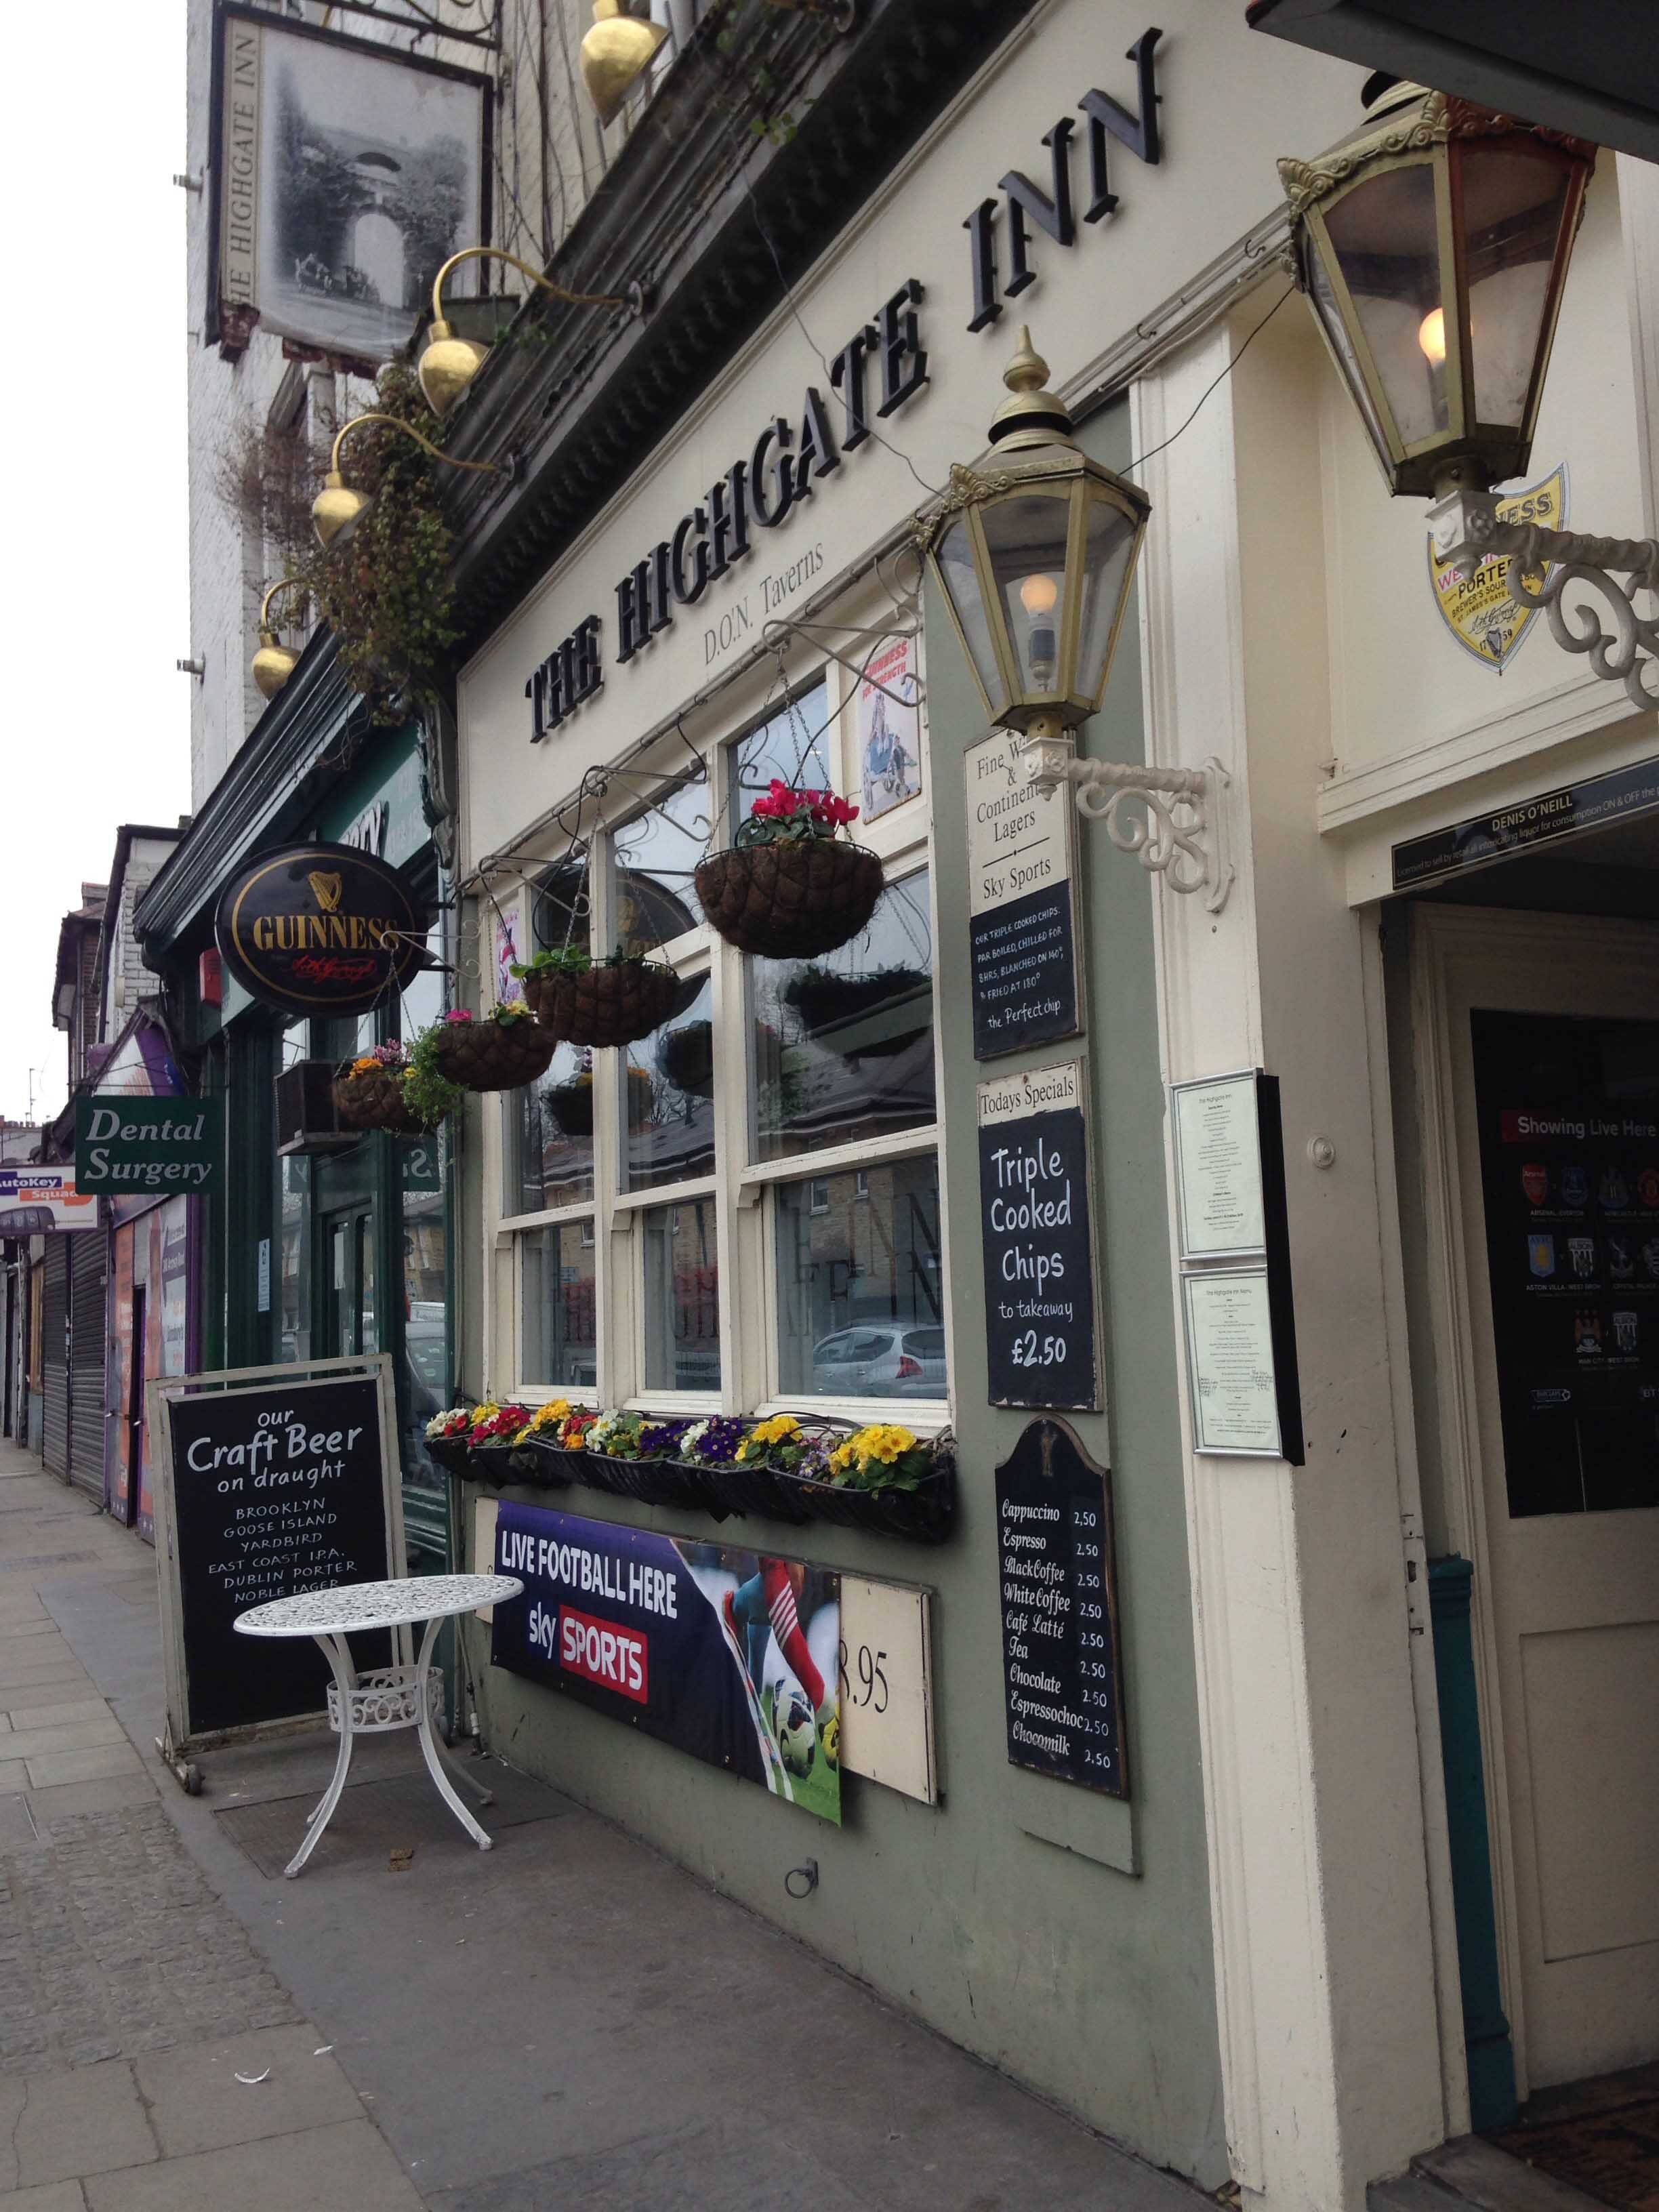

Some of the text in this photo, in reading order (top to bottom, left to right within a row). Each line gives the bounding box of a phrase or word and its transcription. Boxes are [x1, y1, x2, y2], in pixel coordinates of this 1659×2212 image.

[235, 37, 256, 88] INN
[231, 105, 255, 254] HIGHGATE
[525, 27, 1163, 743] THE HIGHGATE INN
[760, 542, 824, 615] Taverns
[1458, 559, 1513, 600] PORTE
[977, 754, 1004, 779] Fine
[1008, 766, 1017, 786] &
[977, 783, 1040, 823] Continent
[1492, 794, 1573, 832] DENIS O'NEILL
[1540, 820, 1551, 830] for
[1552, 805, 1602, 828] consumption
[1603, 799, 1616, 811] ON
[1616, 796, 1624, 806] &
[1624, 790, 1641, 804] OFF
[994, 811, 1036, 842] Lagers
[983, 858, 1051, 900] Sky Sports
[253, 915, 401, 950] GUINNESS
[975, 933, 989, 945] OUR
[989, 924, 1013, 939] TRIPLE
[1014, 915, 1037, 930] COOKED
[977, 951, 991, 964] PAR
[1018, 933, 1048, 949] CHILLED
[1049, 926, 1063, 938] FOR
[1000, 956, 1037, 977] BLANCHED
[1038, 951, 1047, 964] ON
[987, 985, 1009, 1000] FRIED
[1010, 981, 1021, 994] AT
[987, 997, 1061, 1029] the Perfect chip
[981, 1076, 1075, 1115] Todays Specials
[86, 1109, 205, 1142] Dental
[1517, 1116, 1586, 1139] Showing
[1590, 1120, 1619, 1136] Live
[84, 1148, 212, 1185] Surgery
[991, 1137, 1064, 1193] Triple
[0, 1178, 58, 1189] utoKey
[991, 1179, 1071, 1232] Cooked
[1002, 1244, 1065, 1296] Chips
[998, 1298, 1074, 1323] to takeaway
[1011, 1329, 1067, 1367] £2.50
[258, 1410, 293, 1427] our
[187, 1423, 363, 1475] Craft Beer
[218, 1459, 346, 1492] on draught
[224, 1513, 337, 1538] GOOSE ISLAND
[236, 1497, 325, 1520] BROOKLYN
[1002, 1498, 1060, 1523] Cappuccino
[241, 1532, 323, 1553] YARDBIRD
[1002, 1527, 1099, 1557] Espresso 2.50
[209, 1559, 245, 1574] EAST
[253, 1552, 301, 1568] COAST
[224, 1561, 357, 1589] DUBLIN PORTER
[501, 1530, 678, 1620] LIVE FOOTBALL HERE
[1033, 1559, 1065, 1585] Coffee
[235, 1580, 339, 1603] NOBLE LAGER
[1036, 1586, 1070, 1615] Coffee
[1080, 1602, 1102, 1619] 2.50
[1006, 1609, 1104, 1648] Café Latté 2.50
[529, 1601, 643, 1691] sky SPORTS
[1008, 1635, 1106, 1679] Tea 2.50
[1010, 1662, 1061, 1694] Chocolate
[1010, 1690, 1083, 1729] Espressochoc
[1012, 1721, 1111, 1769] Chocomilk 2.50
